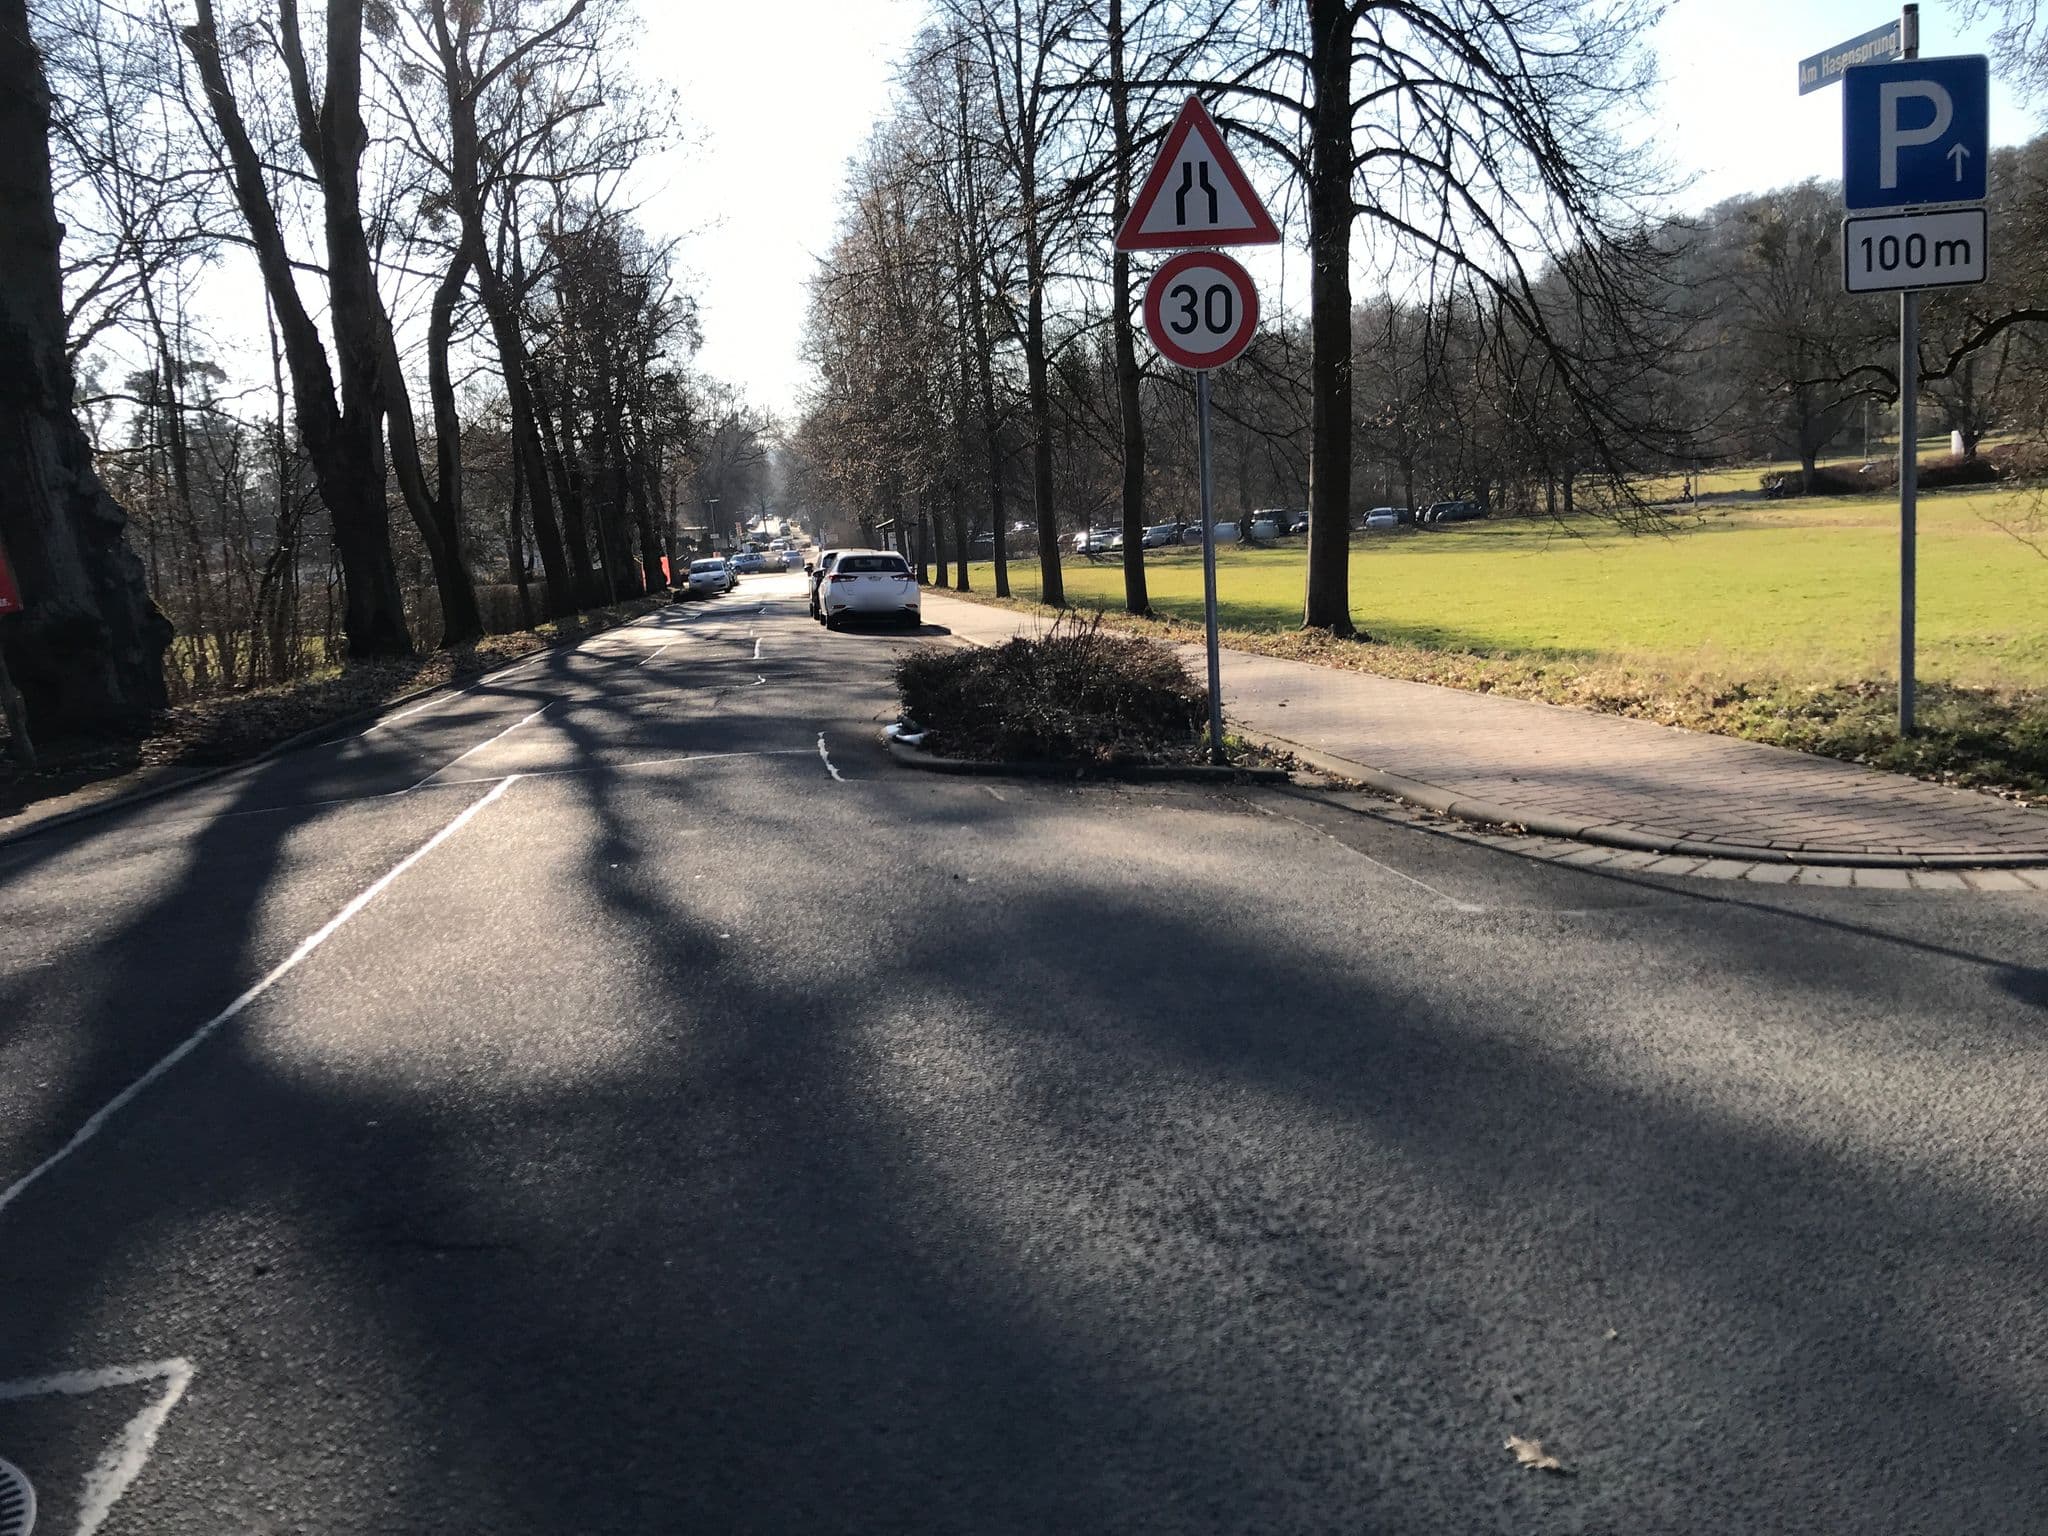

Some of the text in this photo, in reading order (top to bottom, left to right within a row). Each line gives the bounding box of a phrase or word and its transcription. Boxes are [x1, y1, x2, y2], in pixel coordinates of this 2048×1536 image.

[1801, 32, 1896, 85] Am Hasensprung
[1880, 80, 1953, 189] P
[1170, 284, 1232, 334] 30
